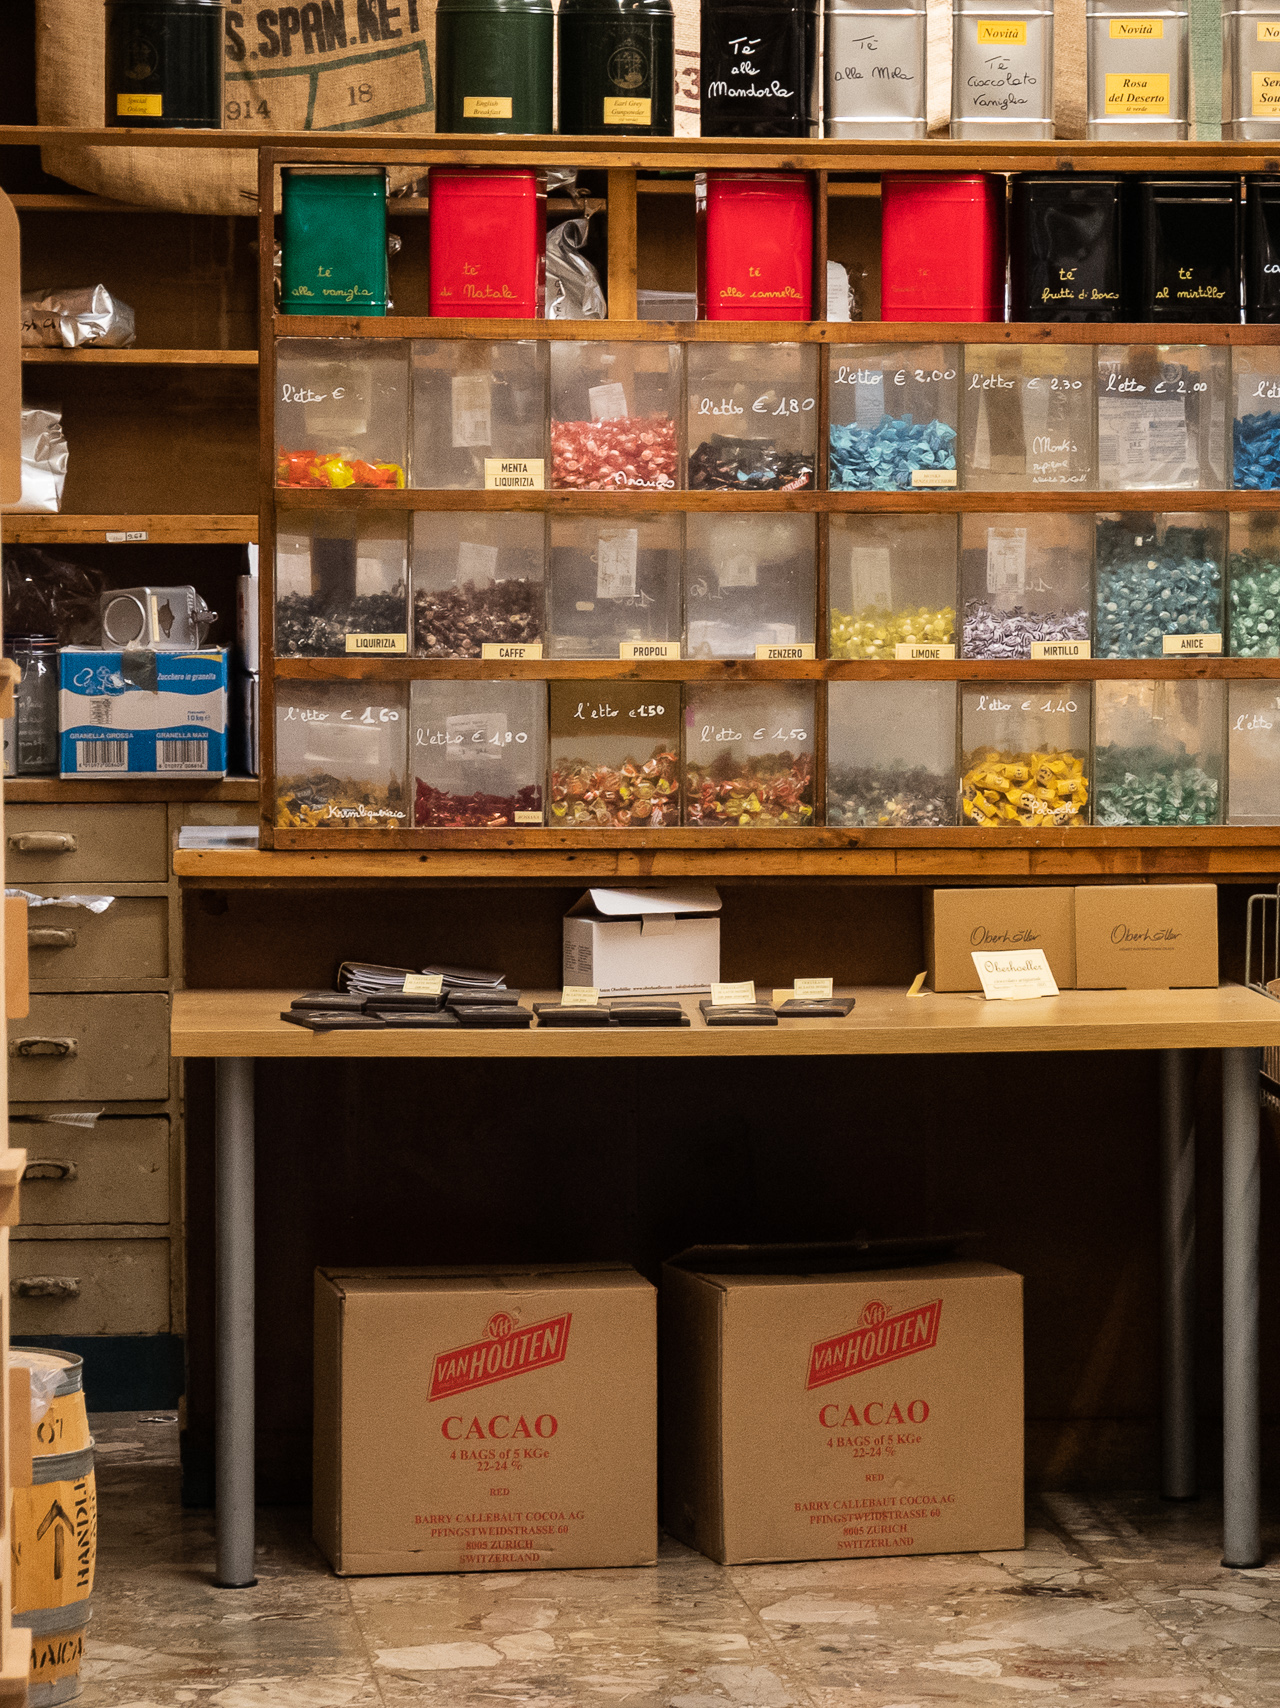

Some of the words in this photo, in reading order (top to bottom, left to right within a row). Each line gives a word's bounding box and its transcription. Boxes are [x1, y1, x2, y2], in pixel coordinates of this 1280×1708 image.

[982, 27, 1020, 40] Novità
[1118, 23, 1153, 35] Novità
[834, 66, 864, 82] alla
[967, 72, 1037, 87] Cioccolato
[707, 80, 794, 99] Mandorla
[1122, 78, 1148, 89] Rosa
[347, 83, 374, 107] 18
[1108, 93, 1124, 103] del
[1125, 93, 1165, 103] Deserto
[475, 100, 499, 109] English
[628, 100, 643, 108] Grey
[973, 93, 1028, 110] Vaniglia
[473, 107, 502, 117] Breakfast
[611, 108, 645, 117] Gunpowder
[291, 286, 315, 297] alla
[322, 286, 374, 302] vaniglia
[440, 287, 452, 297] di
[463, 284, 518, 299] Natale
[719, 286, 745, 299] alla
[749, 285, 804, 299] cannella
[1041, 287, 1075, 304] frutti
[1155, 287, 1170, 299] al
[1176, 285, 1226, 299] mirtillo
[501, 463, 528, 473] MENTA
[494, 477, 535, 487] LIQUIRIZIA
[355, 638, 396, 649] LIQUIRIZIA
[1180, 638, 1204, 649] ANICE
[633, 646, 668, 657] PROPOLI
[768, 648, 803, 659] ZENZERO
[911, 648, 940, 659] LIMONE
[1043, 646, 1079, 656] MIRTILLO
[192, 673, 216, 681] granella
[818, 1399, 930, 1428] CACAO
[441, 1413, 559, 1441] CACAO
[826, 1438, 834, 1448] 4
[837, 1435, 871, 1448] BAGS
[873, 1434, 884, 1446] of
[887, 1434, 894, 1445] 5
[450, 1450, 457, 1460] 4
[460, 1449, 496, 1460] BAGS
[499, 1449, 510, 1460] of
[513, 1449, 520, 1459] 5
[852, 1447, 882, 1458] 22-24
[884, 1446, 895, 1457] %
[476, 1461, 508, 1472] 22-24
[511, 1460, 523, 1471] %
[865, 1473, 885, 1482] RED
[489, 1487, 510, 1497] RED
[794, 1500, 830, 1513] BARRY
[833, 1496, 897, 1510] CALLEBAUT
[899, 1495, 937, 1507] COCOA
[939, 1494, 955, 1504] AG
[414, 1513, 452, 1525] BARRY
[455, 1511, 524, 1524] CALLEBAUT
[525, 1511, 565, 1522] COCOA
[568, 1510, 585, 1521] AG
[809, 1509, 928, 1525] PFINGSTWEIDSTRASSE
[930, 1508, 941, 1519] 60
[430, 1525, 554, 1538] PFINGSTWEIDSTRASSE
[557, 1524, 569, 1535] 60
[842, 1526, 865, 1537] 8005
[866, 1523, 908, 1536] ZURICH
[465, 1540, 488, 1551] 8005
[490, 1539, 534, 1550] ZURICH
[836, 1537, 914, 1550] SWITZERLAND
[459, 1552, 541, 1565] SWITZERLAND
